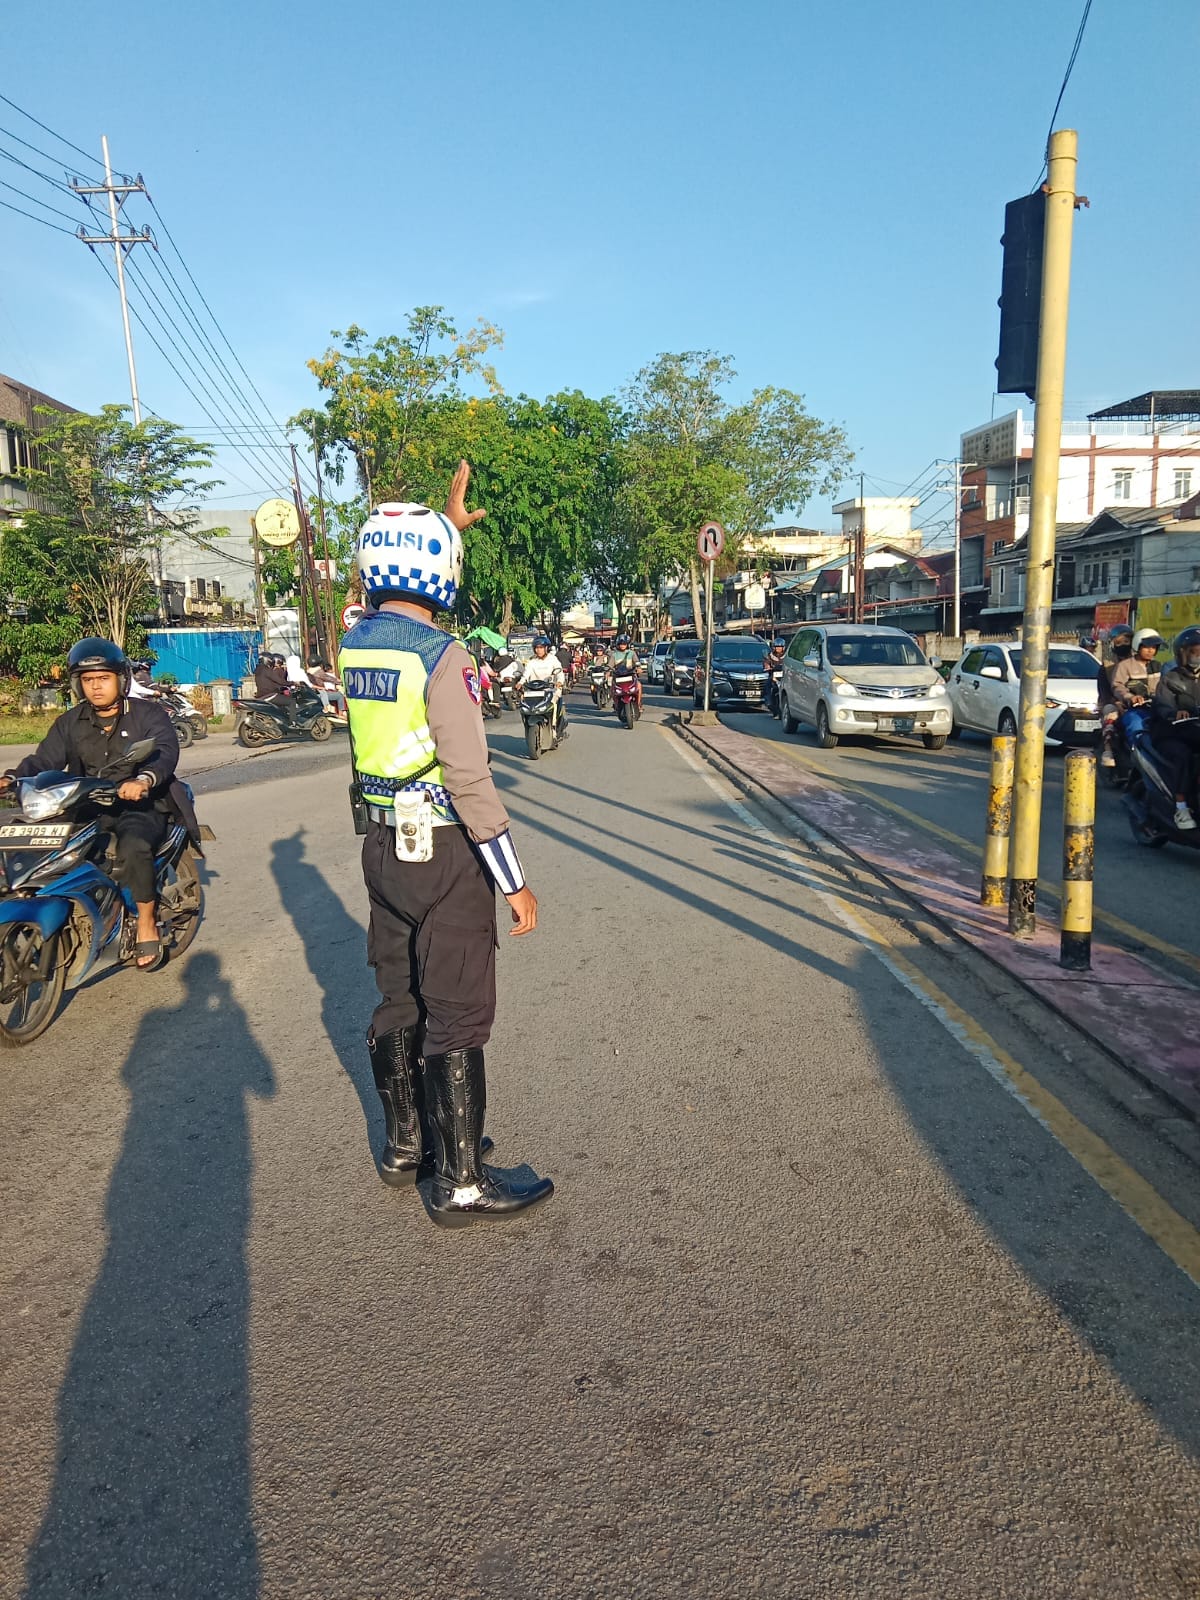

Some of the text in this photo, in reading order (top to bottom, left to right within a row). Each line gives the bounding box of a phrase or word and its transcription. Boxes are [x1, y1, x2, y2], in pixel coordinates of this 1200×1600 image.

[362, 530, 423, 551] POLISI
[344, 670, 396, 698] POLISI
[1, 827, 16, 837] KB
[19, 826, 47, 837] 3909
